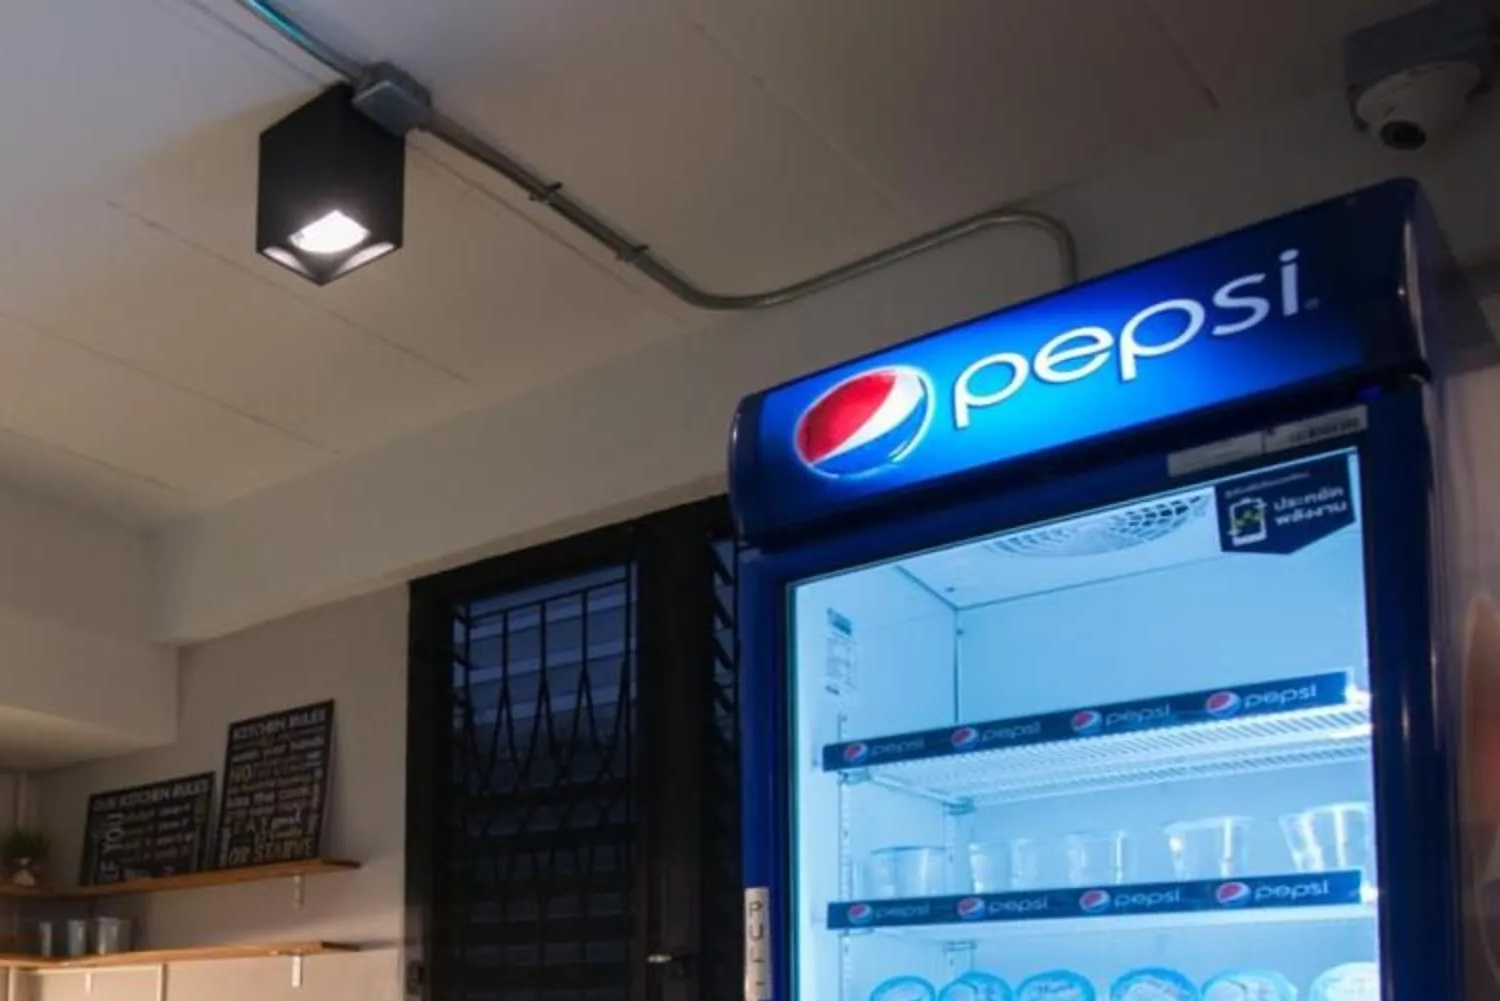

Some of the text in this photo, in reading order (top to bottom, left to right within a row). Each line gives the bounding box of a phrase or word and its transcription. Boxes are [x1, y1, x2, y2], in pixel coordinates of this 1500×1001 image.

[953, 249, 1299, 428] pepsi
[1244, 683, 1317, 708] pepsi
[1106, 704, 1170, 726] pepsi
[1114, 888, 1180, 908] pepsi
[1254, 880, 1329, 901] pepsi
[988, 895, 1048, 913] pepsi
